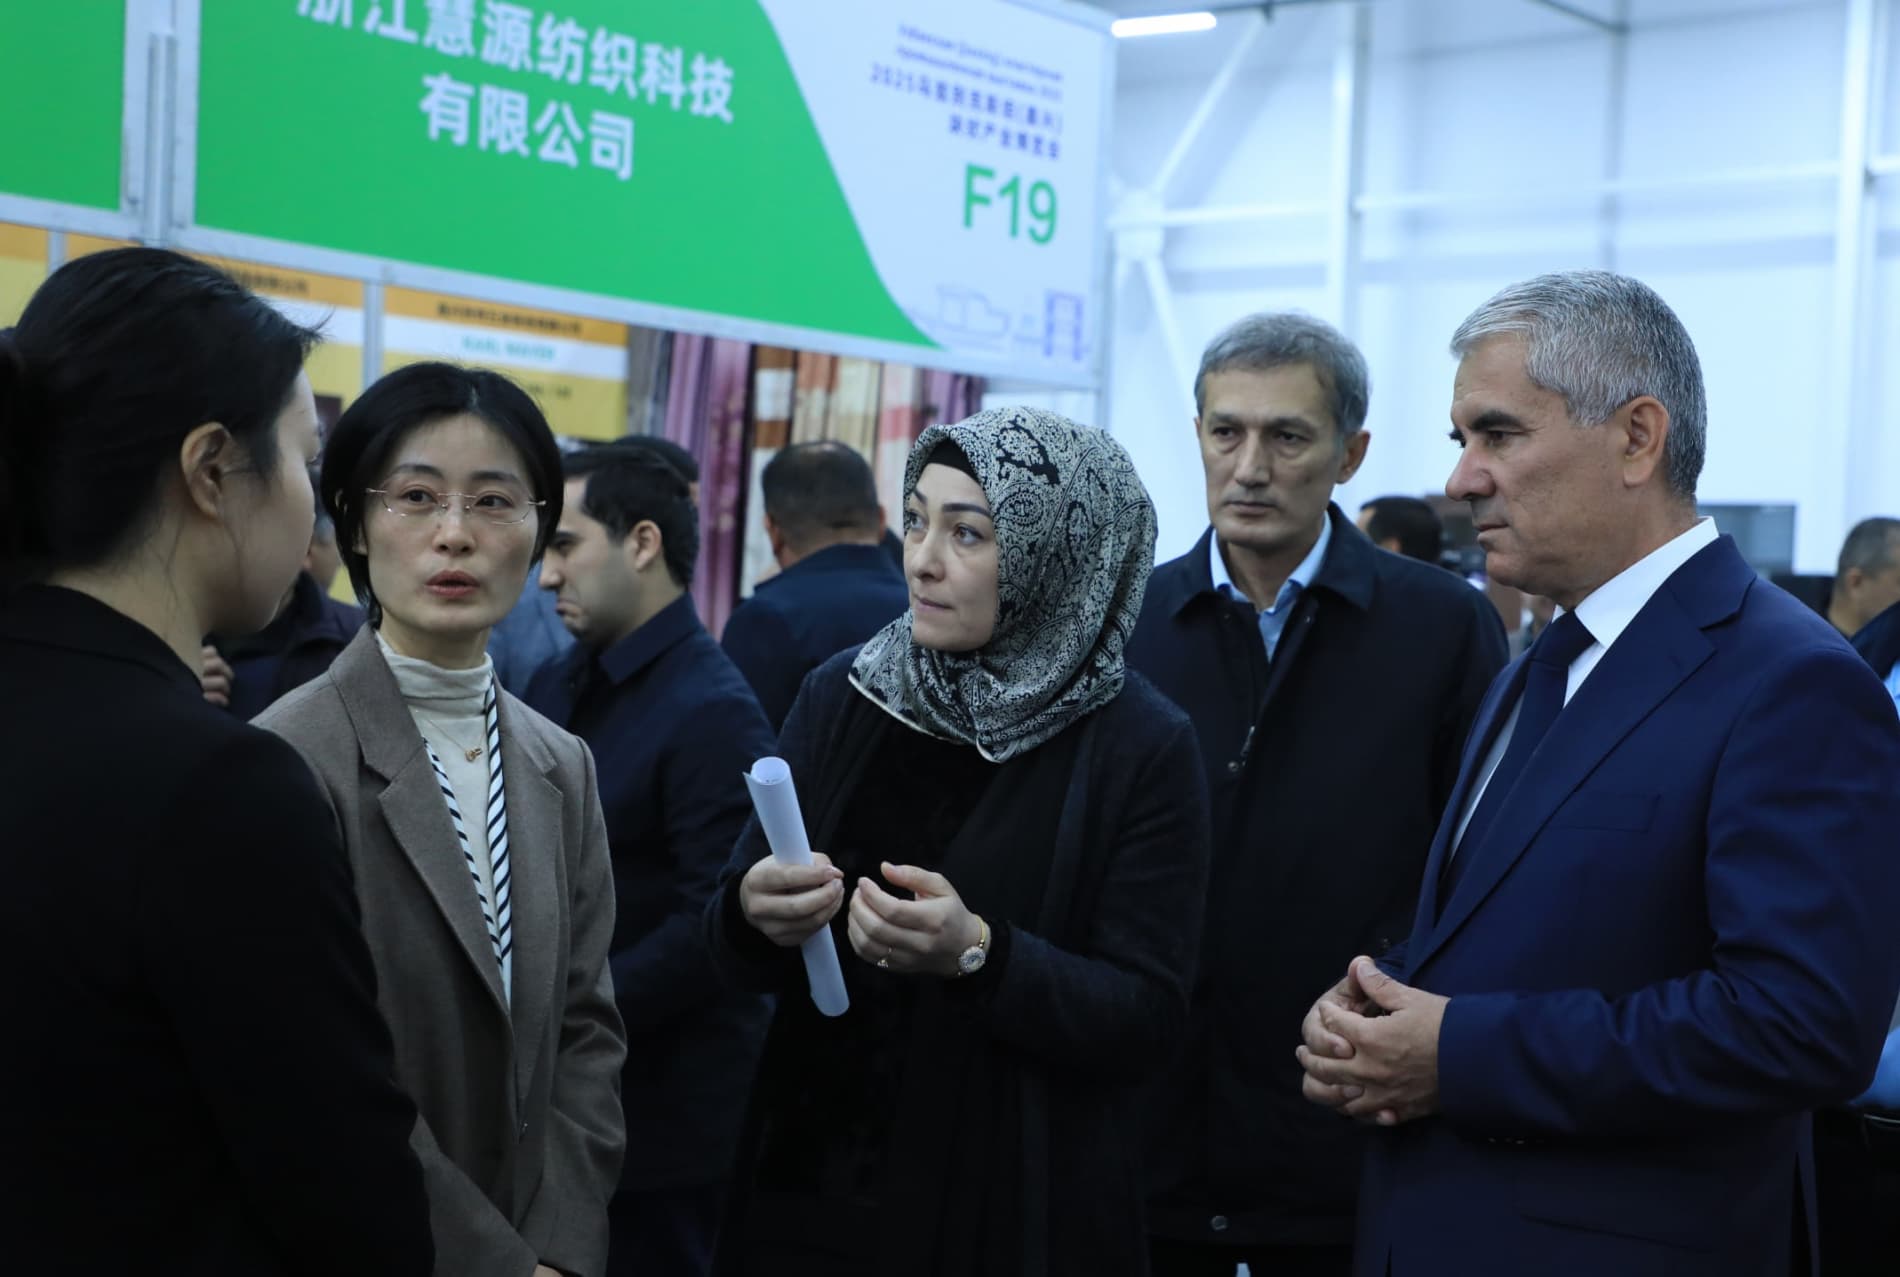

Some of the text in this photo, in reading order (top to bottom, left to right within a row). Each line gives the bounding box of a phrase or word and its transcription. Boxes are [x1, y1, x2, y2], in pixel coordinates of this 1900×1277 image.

[421, 73, 634, 180] 有限公司
[963, 163, 1058, 246] F19
